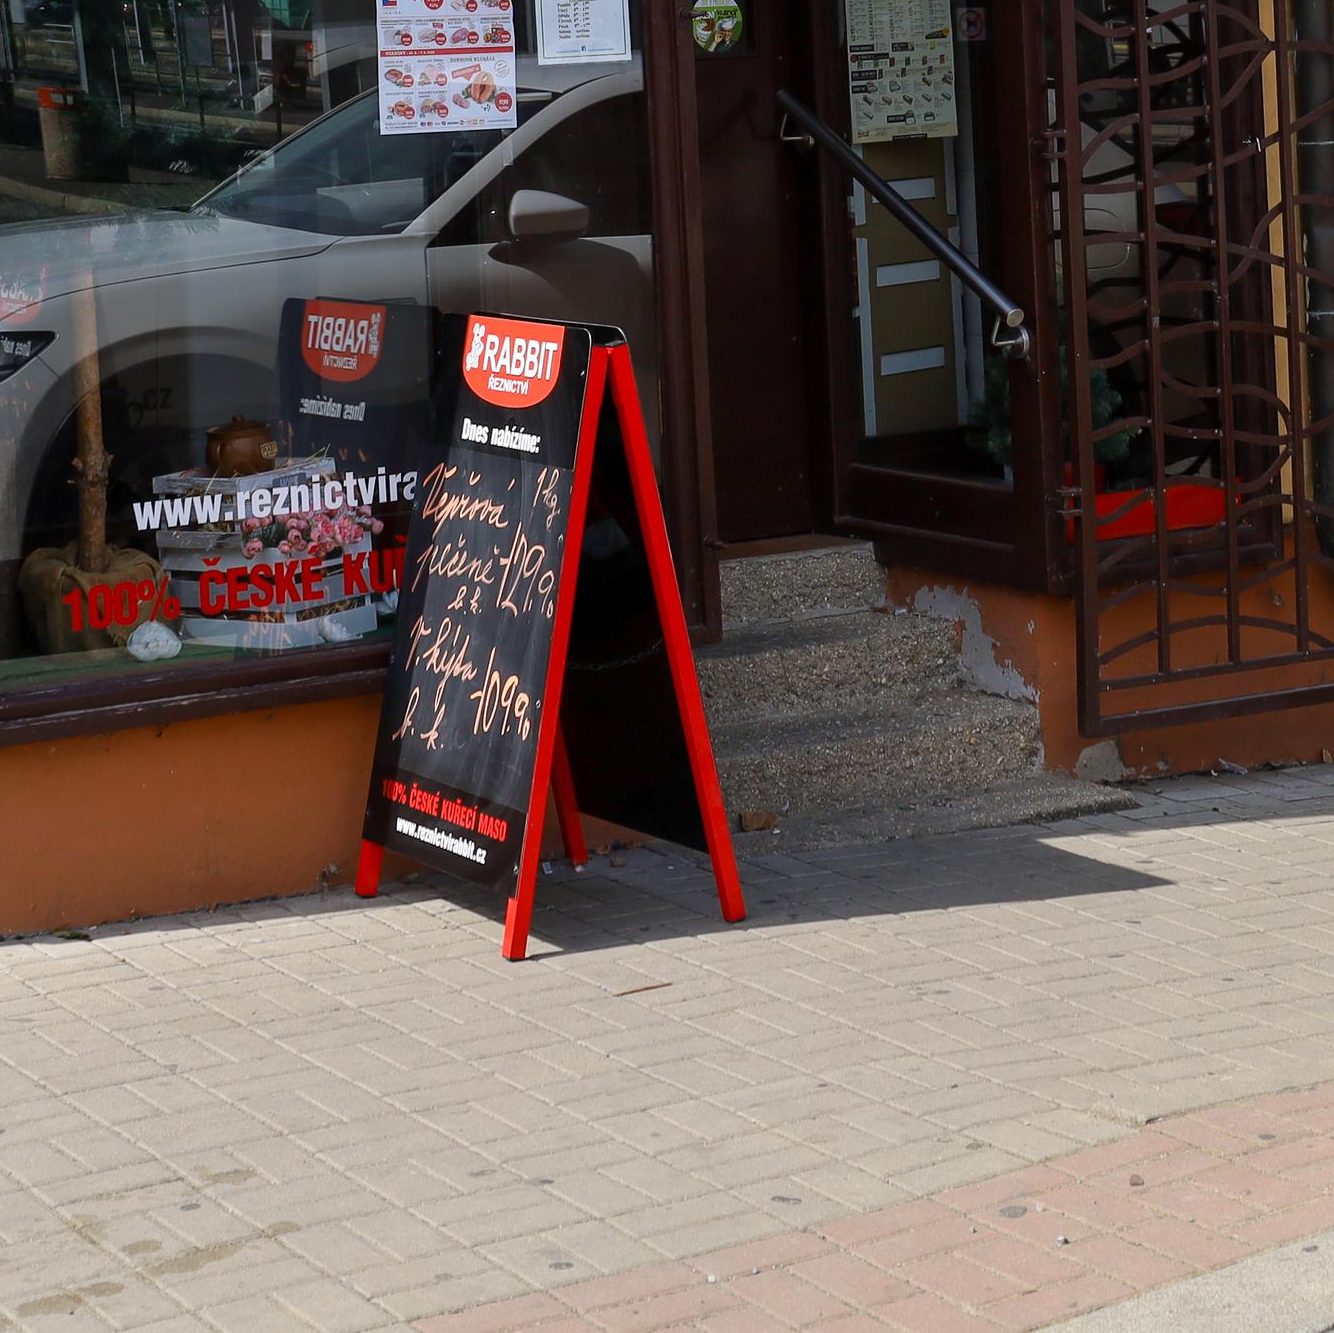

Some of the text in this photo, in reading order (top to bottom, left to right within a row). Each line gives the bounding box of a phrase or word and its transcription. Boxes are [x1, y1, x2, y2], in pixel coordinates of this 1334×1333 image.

[483, 334, 559, 380] RABBIT
[488, 374, 529, 395] ŘEZNICTVÍ
[461, 417, 541, 454] Dnes nabízíme:
[62, 574, 182, 633] 100%
[382, 779, 507, 843] 100% ČESKÉ KUŘECÍ MASO
[396, 817, 487, 865] www.reznictvirabbit.cz
